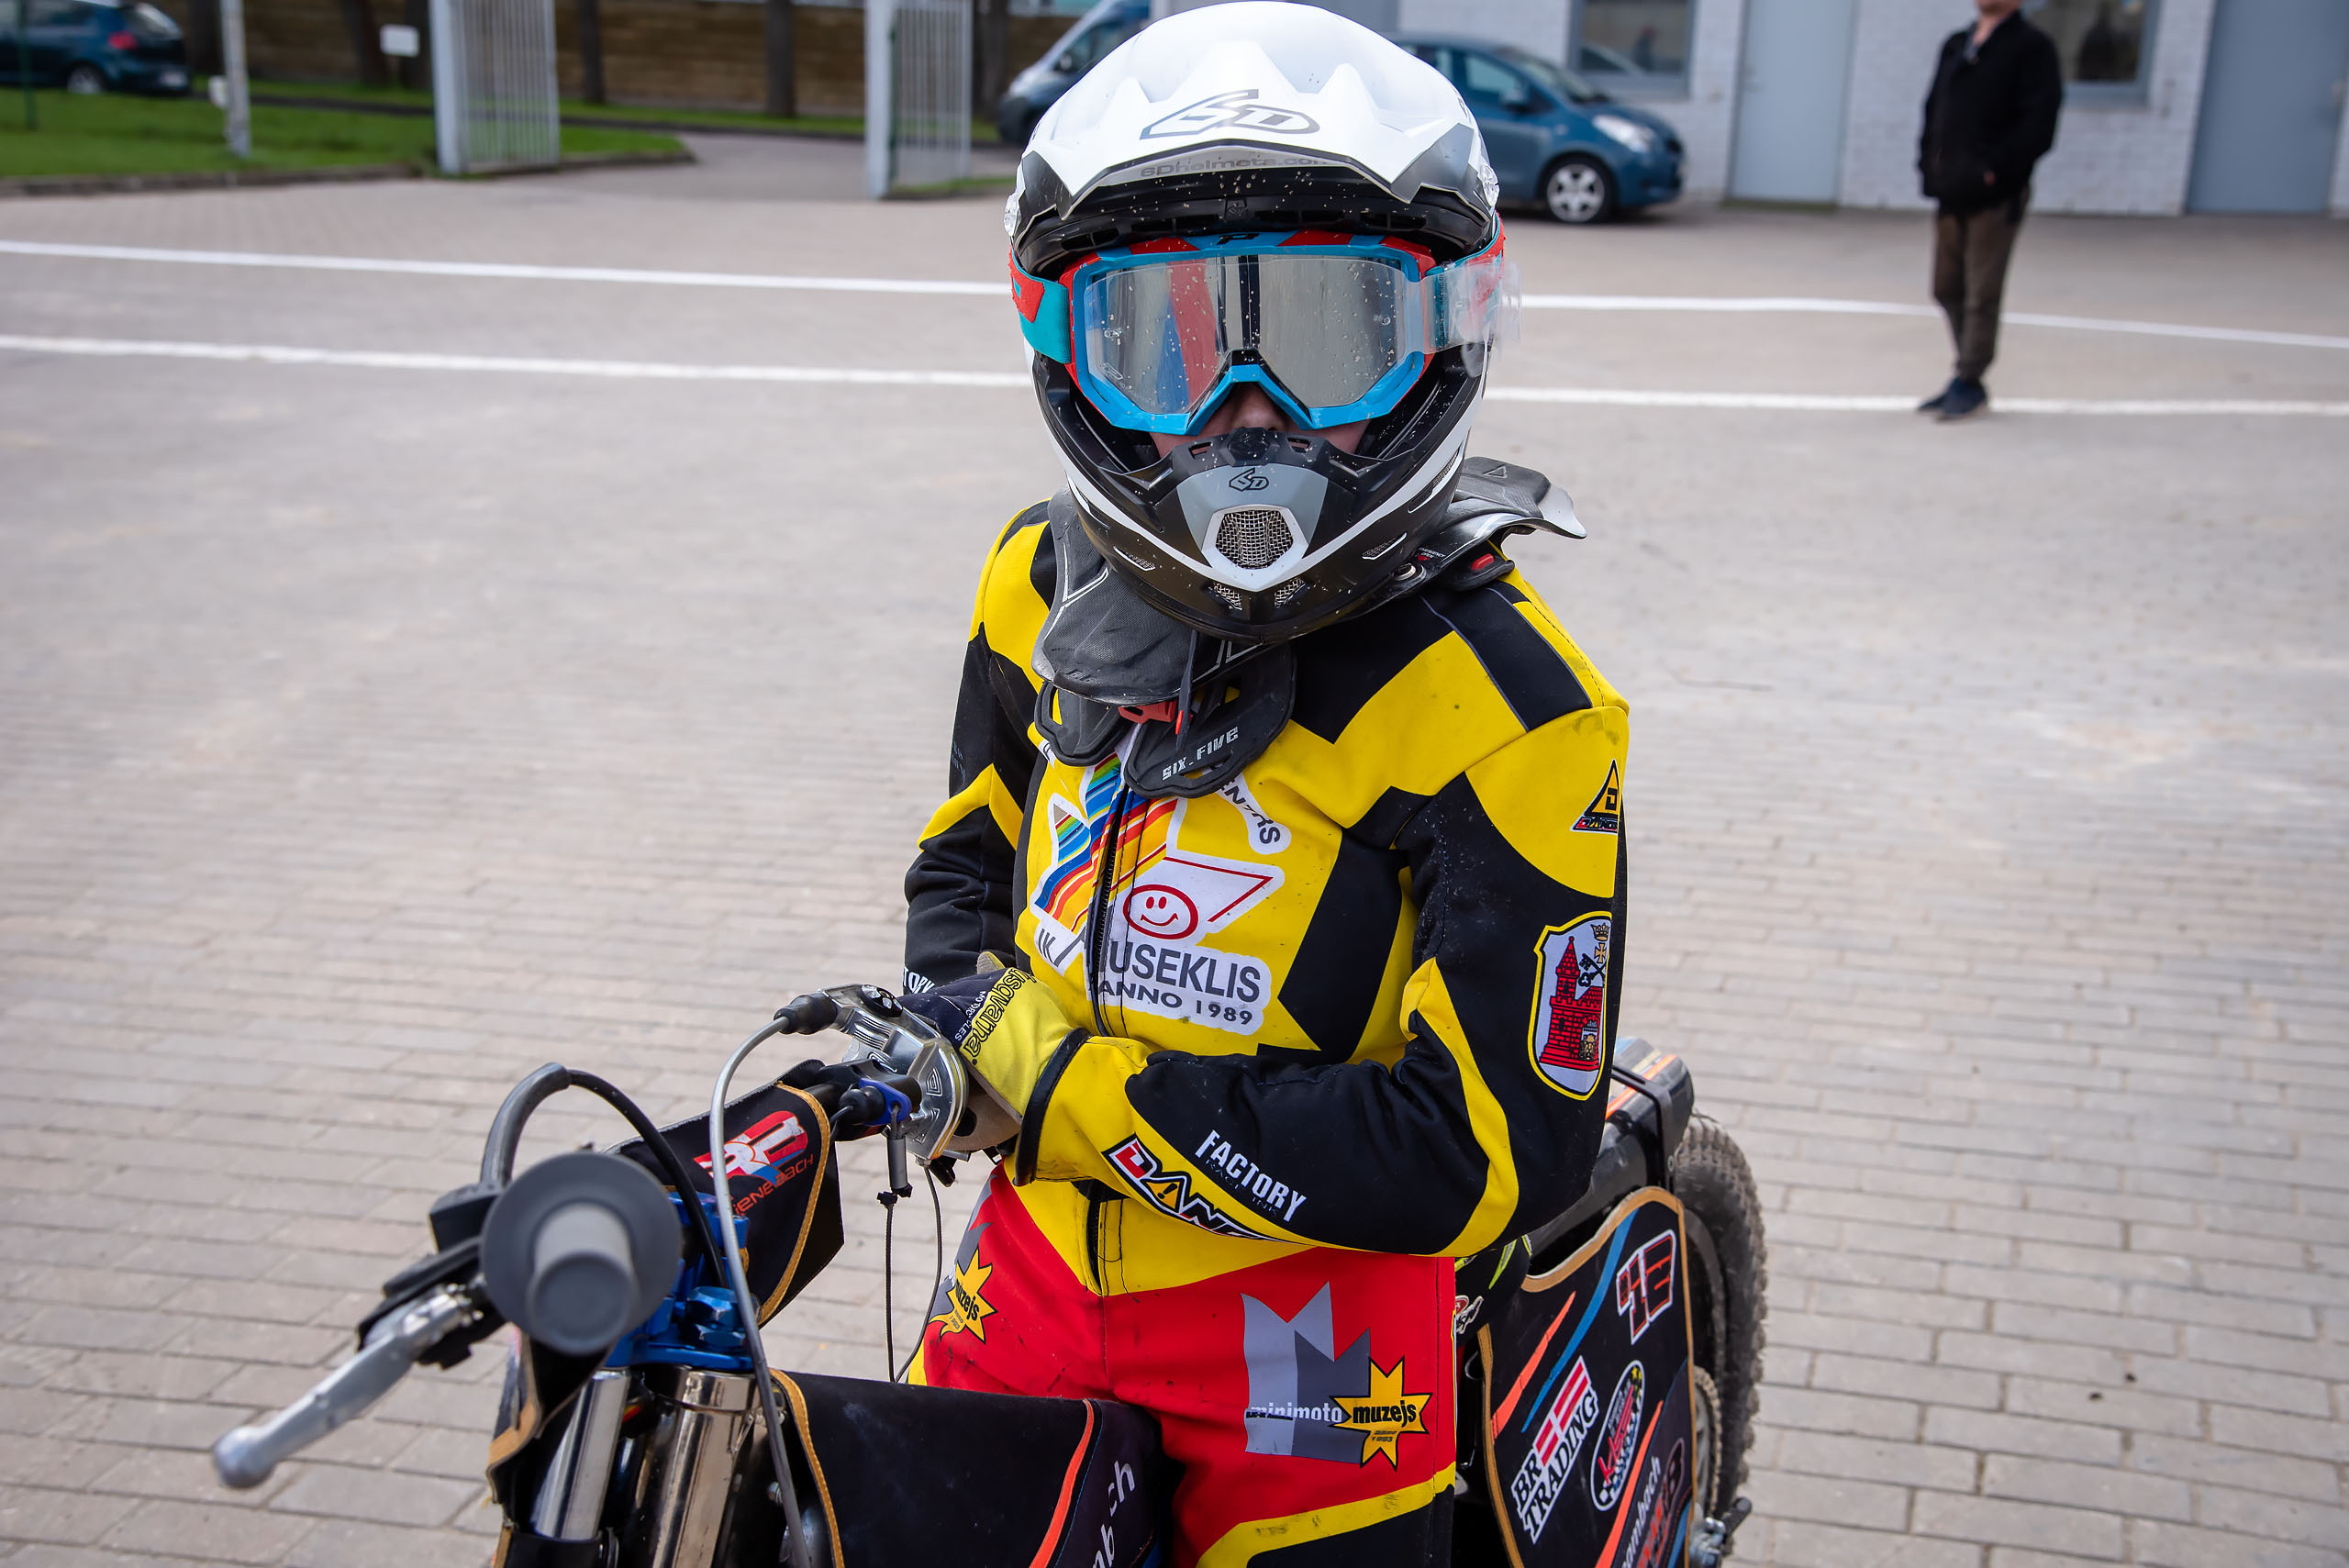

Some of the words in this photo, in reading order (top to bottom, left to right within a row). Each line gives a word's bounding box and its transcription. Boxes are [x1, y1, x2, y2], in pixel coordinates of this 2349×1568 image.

[1228, 466, 1270, 493] 6D
[1098, 980, 1183, 1008] ANNO
[1196, 999, 1253, 1025] 1989
[1195, 1129, 1308, 1222] FACTORY
[1353, 1400, 1417, 1429] muzejs
[1514, 1449, 1543, 1514] BR
[1523, 1391, 1596, 1538] TRADING
